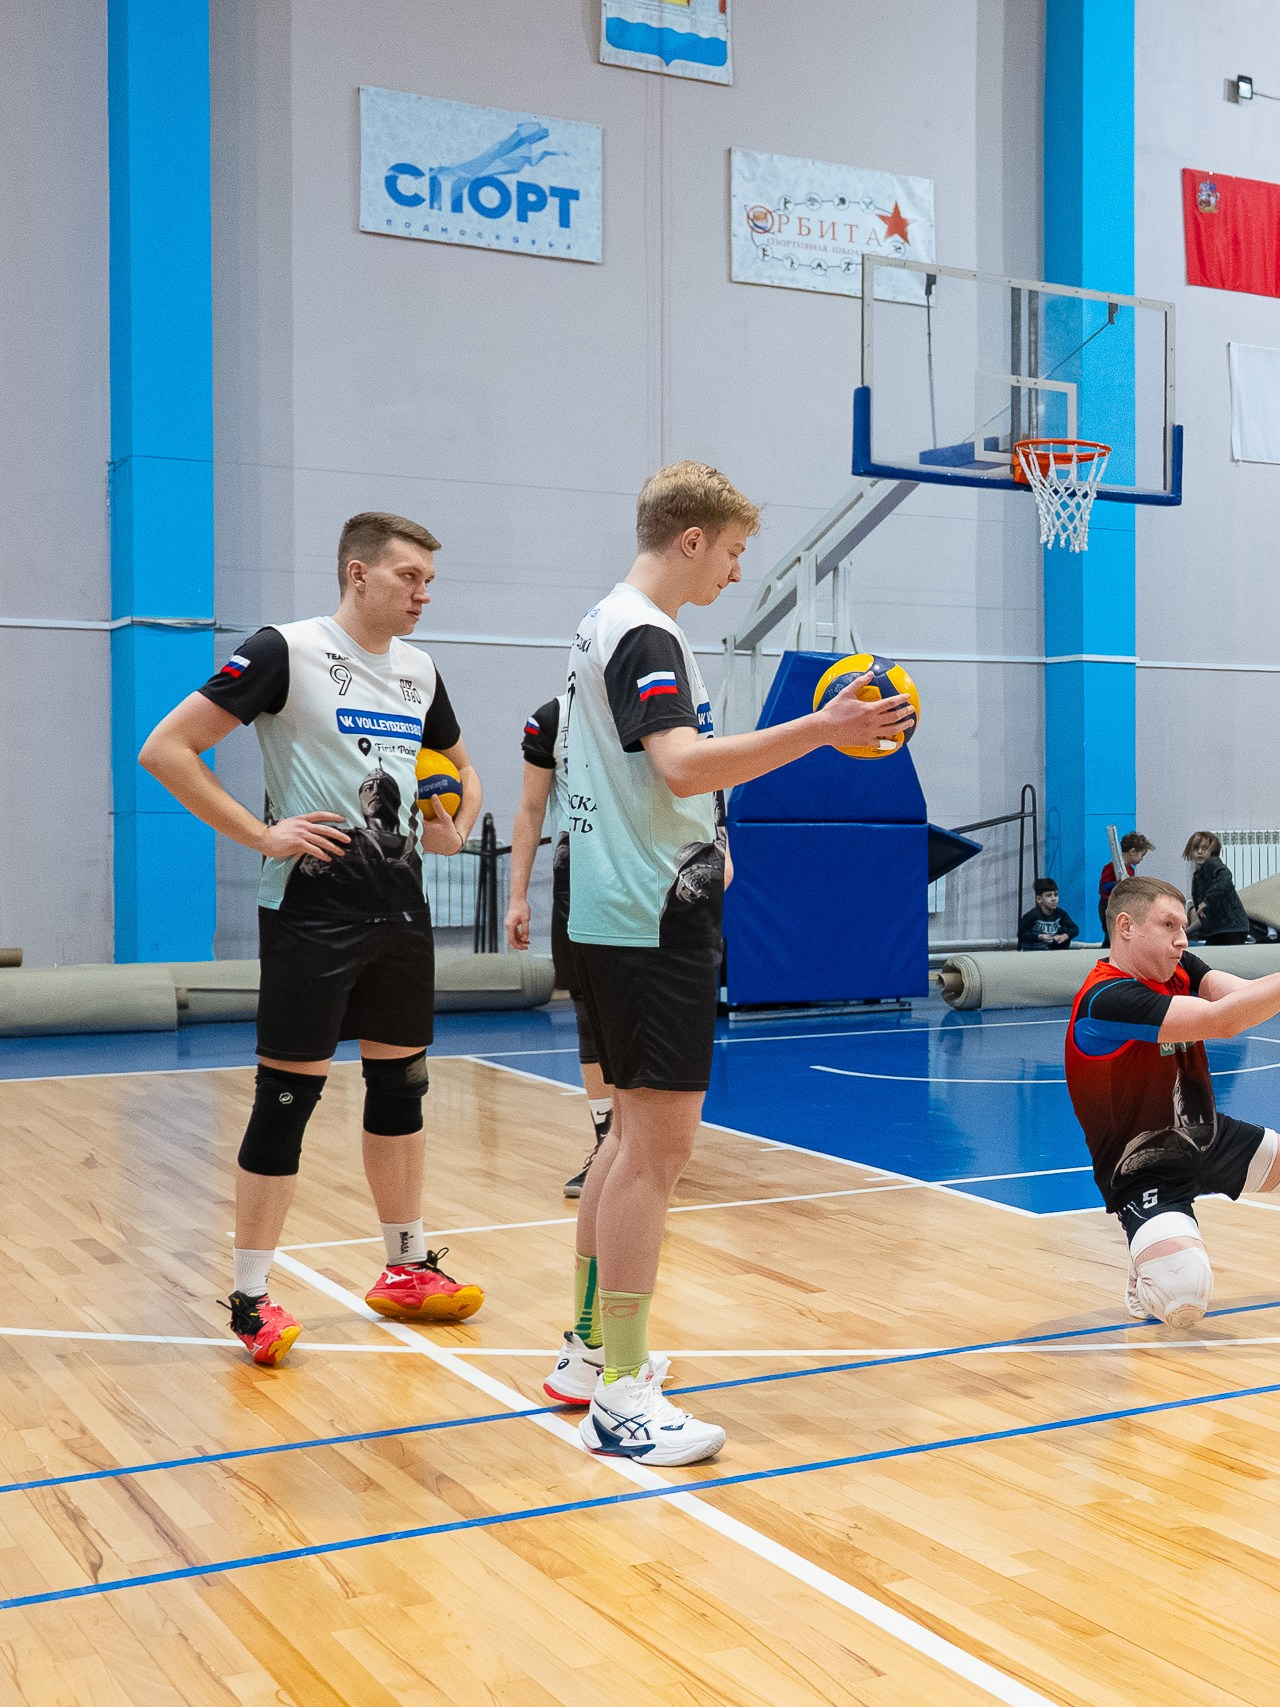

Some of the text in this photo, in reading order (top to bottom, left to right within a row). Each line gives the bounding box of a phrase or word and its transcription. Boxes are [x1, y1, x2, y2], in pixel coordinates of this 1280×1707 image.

[384, 162, 579, 229] СПОРТ
[329, 664, 352, 696] 9
[339, 715, 355, 728] VK
[1143, 1188, 1158, 1209] 5
